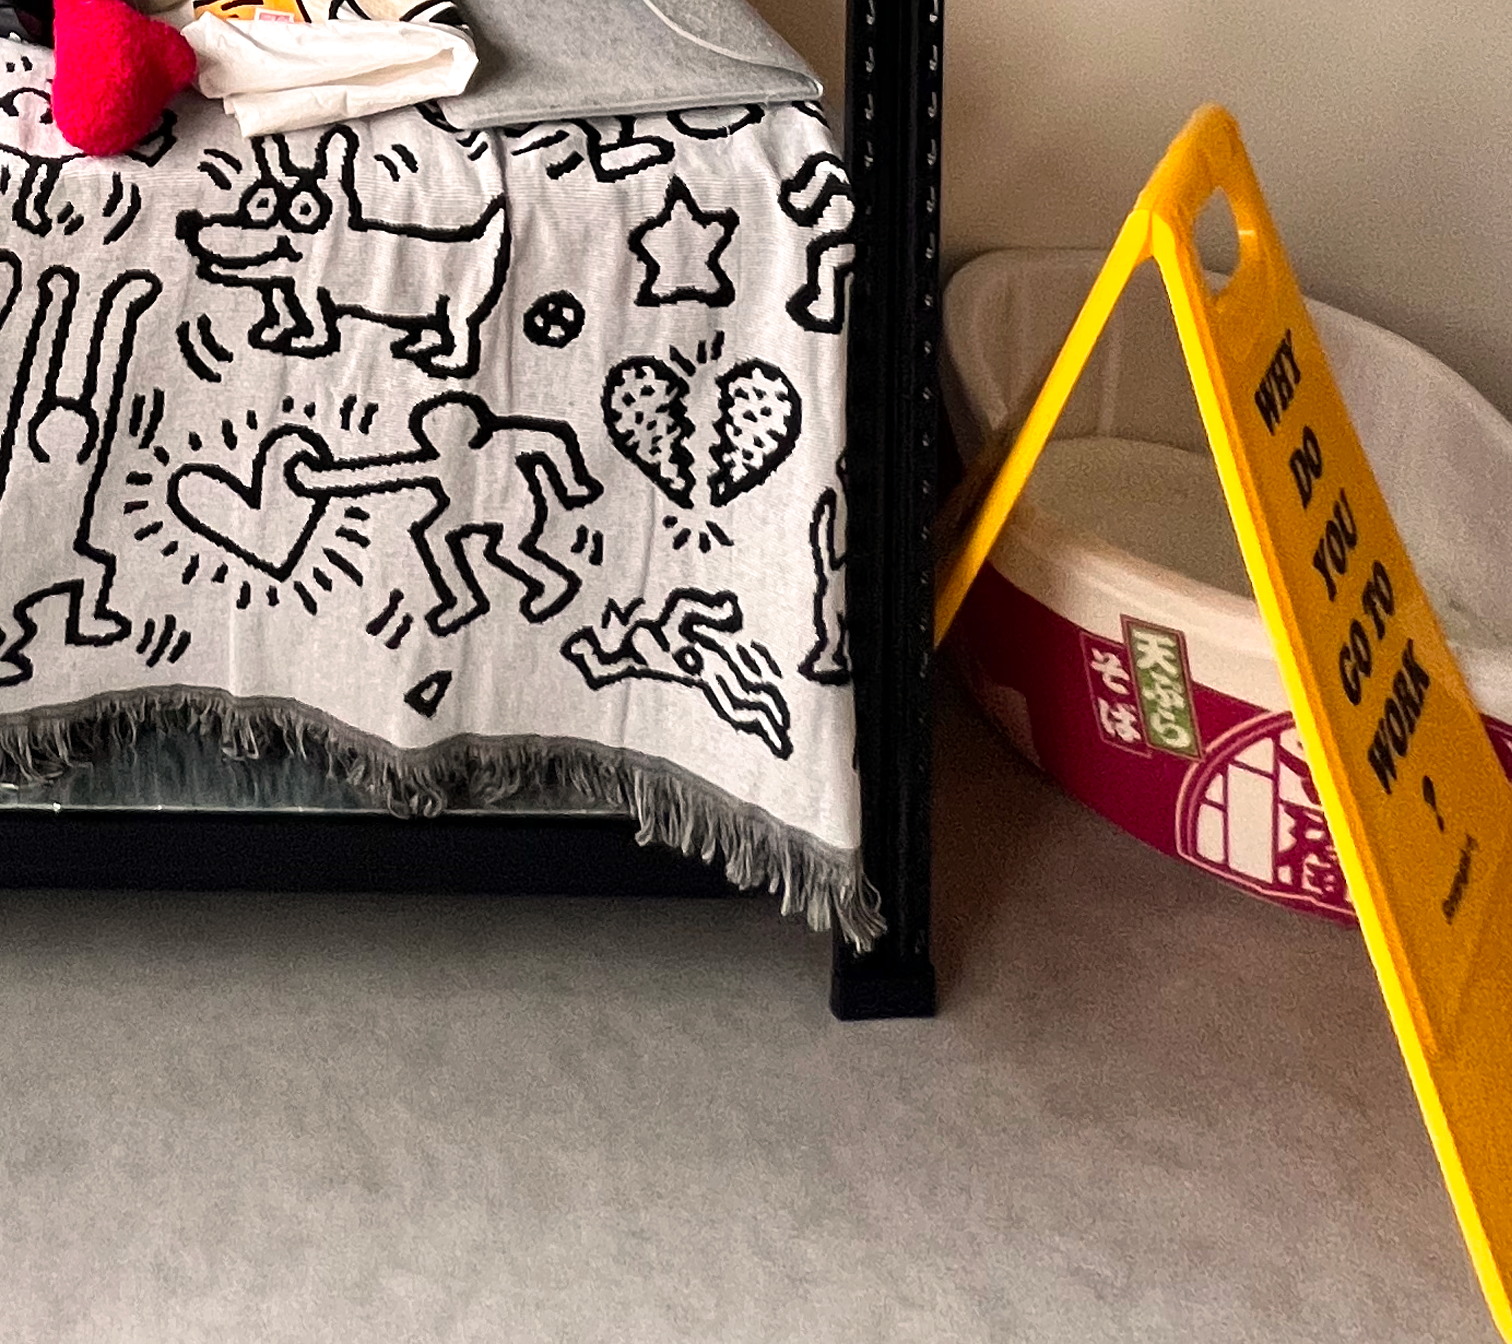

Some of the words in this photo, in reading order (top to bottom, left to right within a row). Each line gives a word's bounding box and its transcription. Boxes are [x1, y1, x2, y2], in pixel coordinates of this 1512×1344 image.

[1254, 328, 1301, 437] WHY
[1289, 425, 1323, 511] DO
[1312, 487, 1358, 603] YOU
[1131, 627, 1191, 749] 天ぷら
[1339, 618, 1373, 706] GO
[1362, 559, 1395, 641] TO
[1090, 647, 1142, 744] そば
[1367, 637, 1431, 795] WORK
